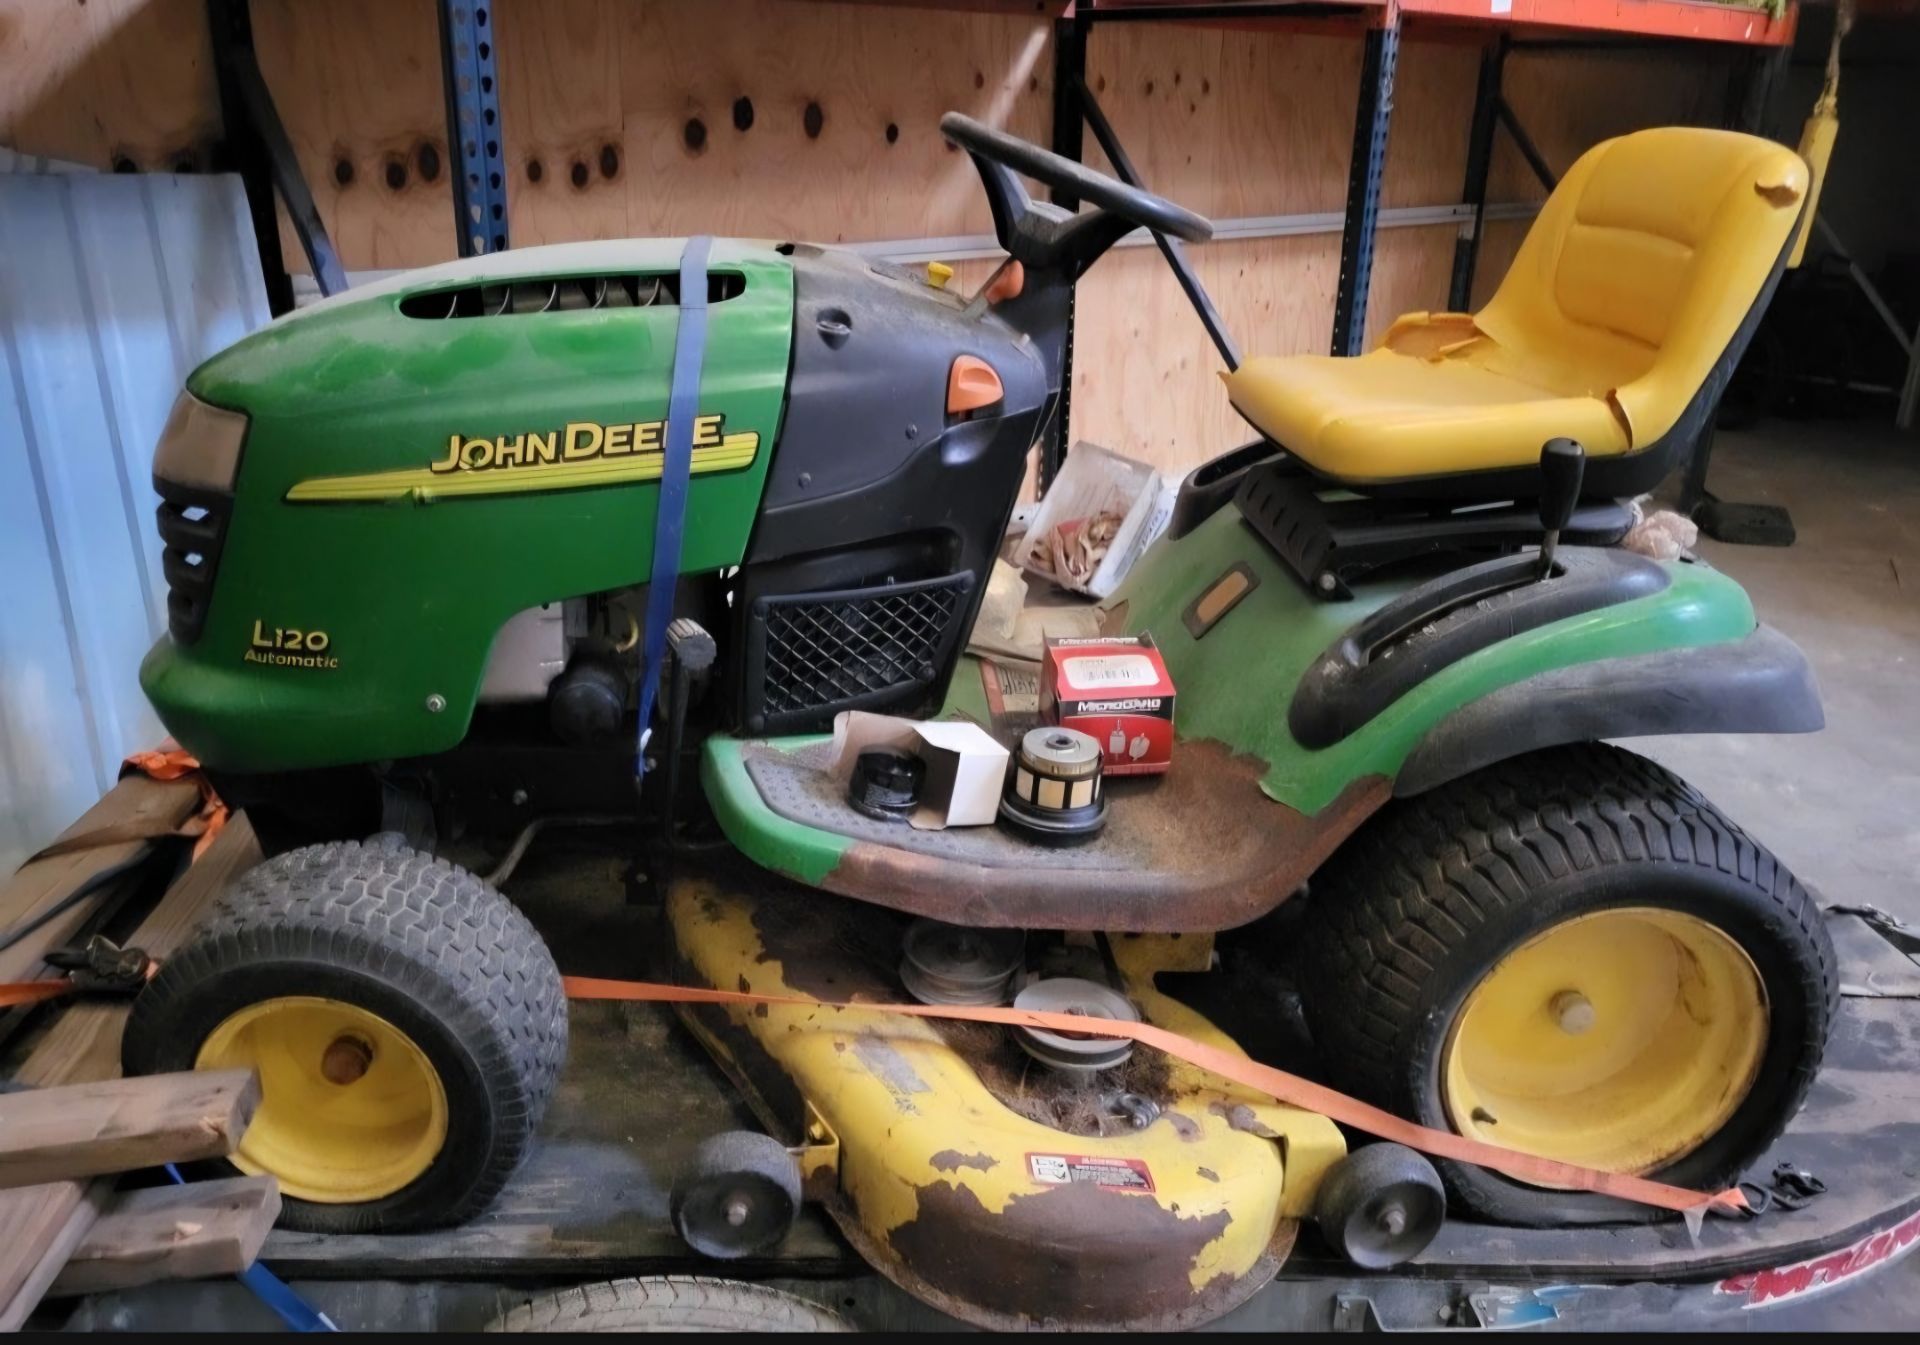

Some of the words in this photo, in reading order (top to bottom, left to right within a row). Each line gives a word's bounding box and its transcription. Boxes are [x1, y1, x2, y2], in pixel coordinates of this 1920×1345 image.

[431, 433, 557, 473] JOHN
[564, 413, 724, 458] DEEE
[252, 618, 329, 651] L120
[244, 648, 338, 669] Automatic
